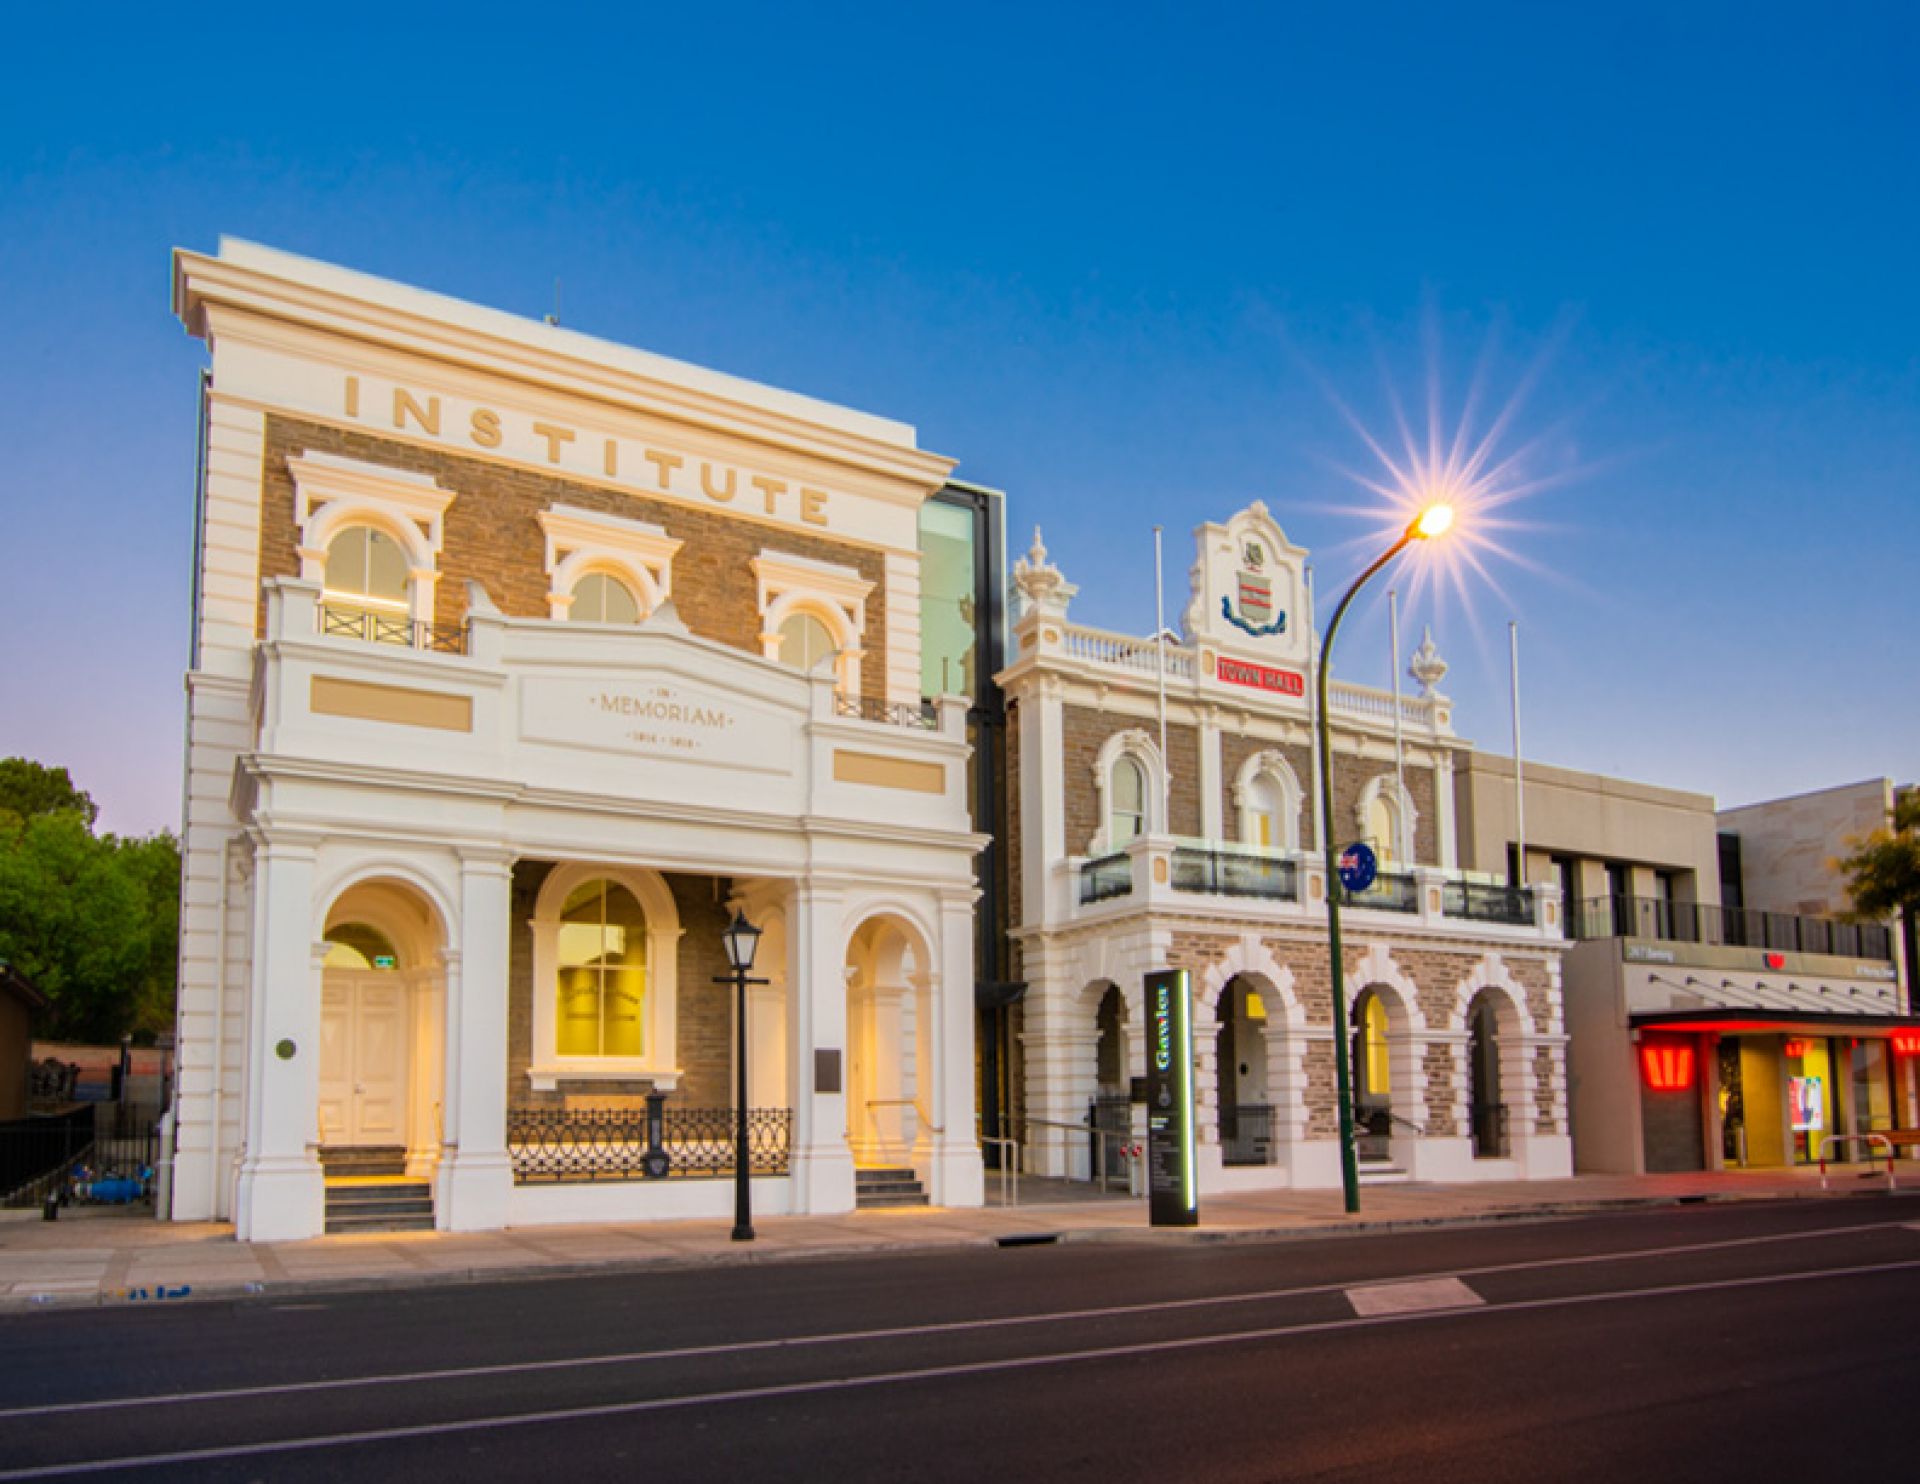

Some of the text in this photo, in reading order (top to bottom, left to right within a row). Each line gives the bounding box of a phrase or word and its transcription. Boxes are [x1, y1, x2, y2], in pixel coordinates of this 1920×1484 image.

[345, 375, 829, 527] INSTITUTE
[1219, 661, 1301, 693] TOWN HALL
[600, 693, 726, 728] MEMORIAM
[1155, 984, 1169, 1071] Gawler
